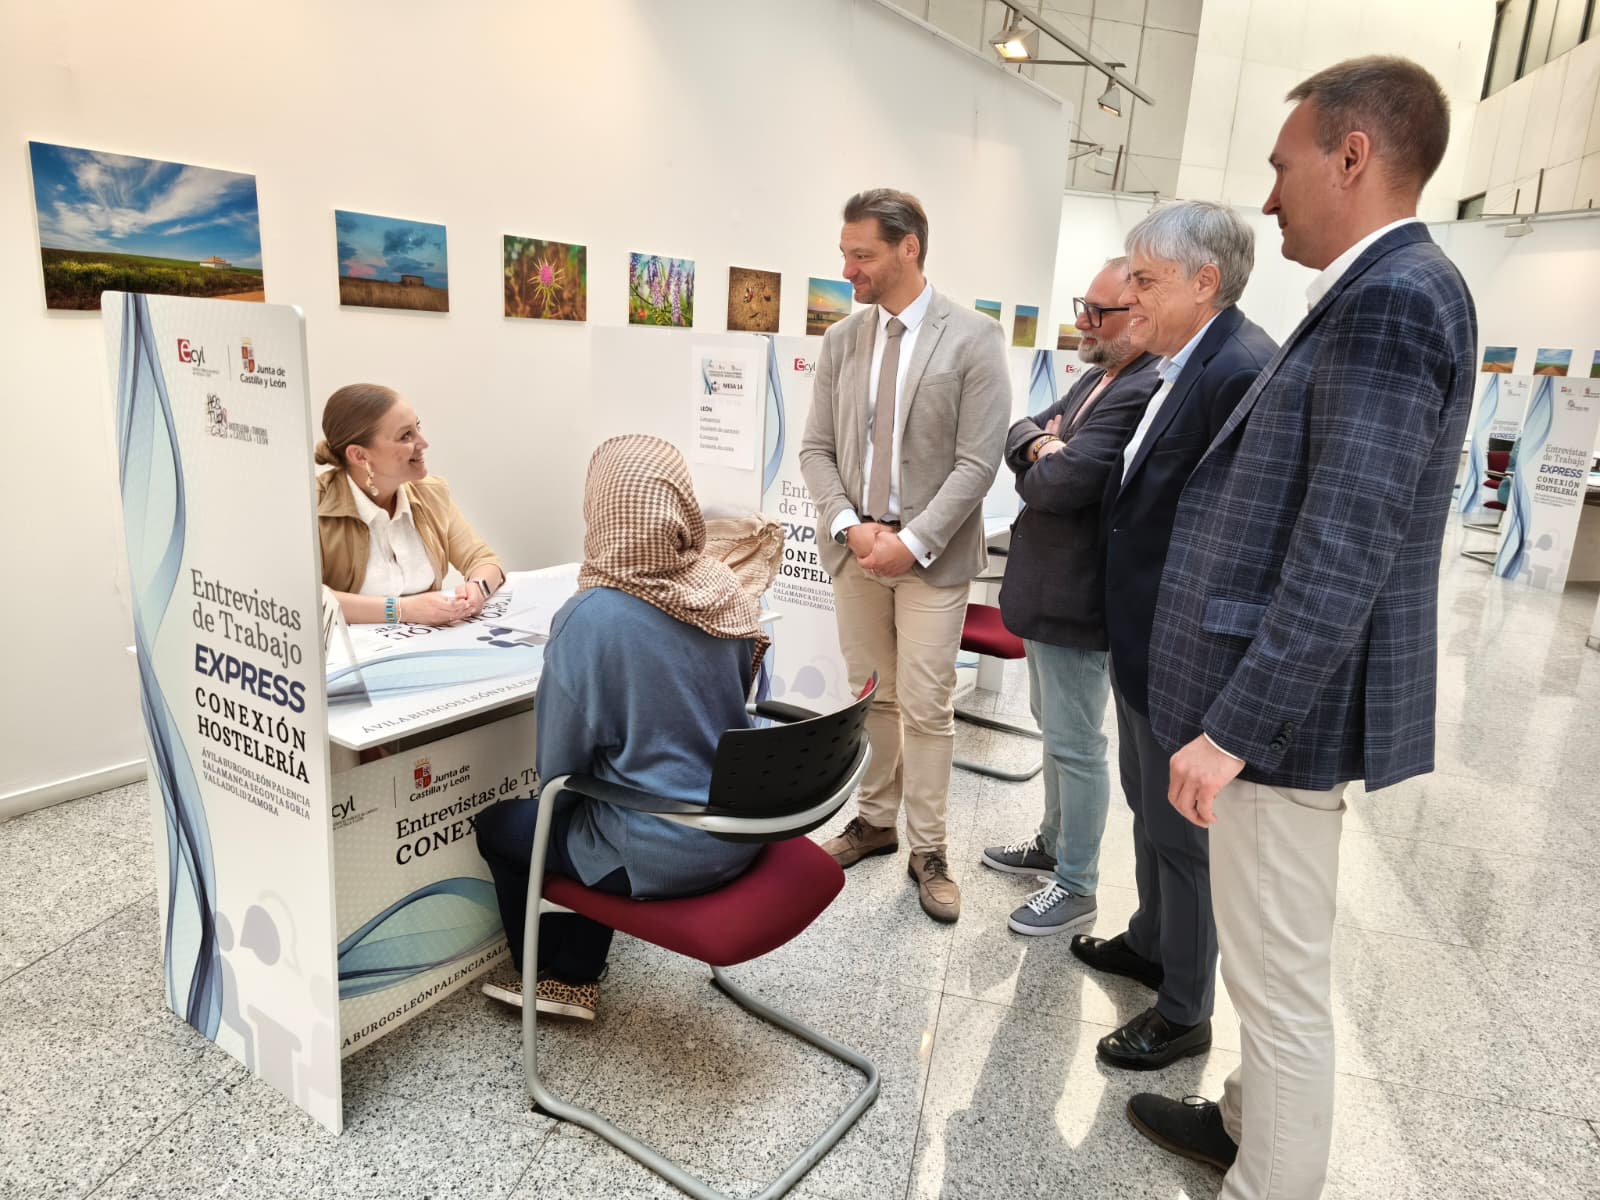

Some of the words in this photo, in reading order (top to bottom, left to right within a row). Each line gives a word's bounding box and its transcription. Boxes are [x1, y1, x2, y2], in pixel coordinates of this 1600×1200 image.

[240, 373, 263, 385] Castilla
[263, 379, 270, 388] y
[270, 377, 287, 389] León
[257, 364, 275, 375] Junta
[276, 367, 286, 376] de
[1537, 476, 1580, 488] CONEXIÓN
[1540, 464, 1584, 478] EXPRESS
[1535, 483, 1578, 496] HOSTELERÍA
[779, 499, 797, 515] de
[190, 568, 302, 631] Entrevistas
[192, 602, 215, 633] de
[219, 610, 302, 669] Trabajo
[194, 643, 306, 713] EXPRESS
[195, 687, 306, 752] CONEXIÓN
[197, 714, 310, 784] HOSTELERÍA
[433, 769, 458, 784] Junta
[457, 764, 470, 776] de
[409, 785, 441, 802] Castilla
[443, 782, 449, 793] y
[450, 774, 471, 788] León
[395, 787, 496, 840] Entrevistas
[499, 776, 518, 795] de
